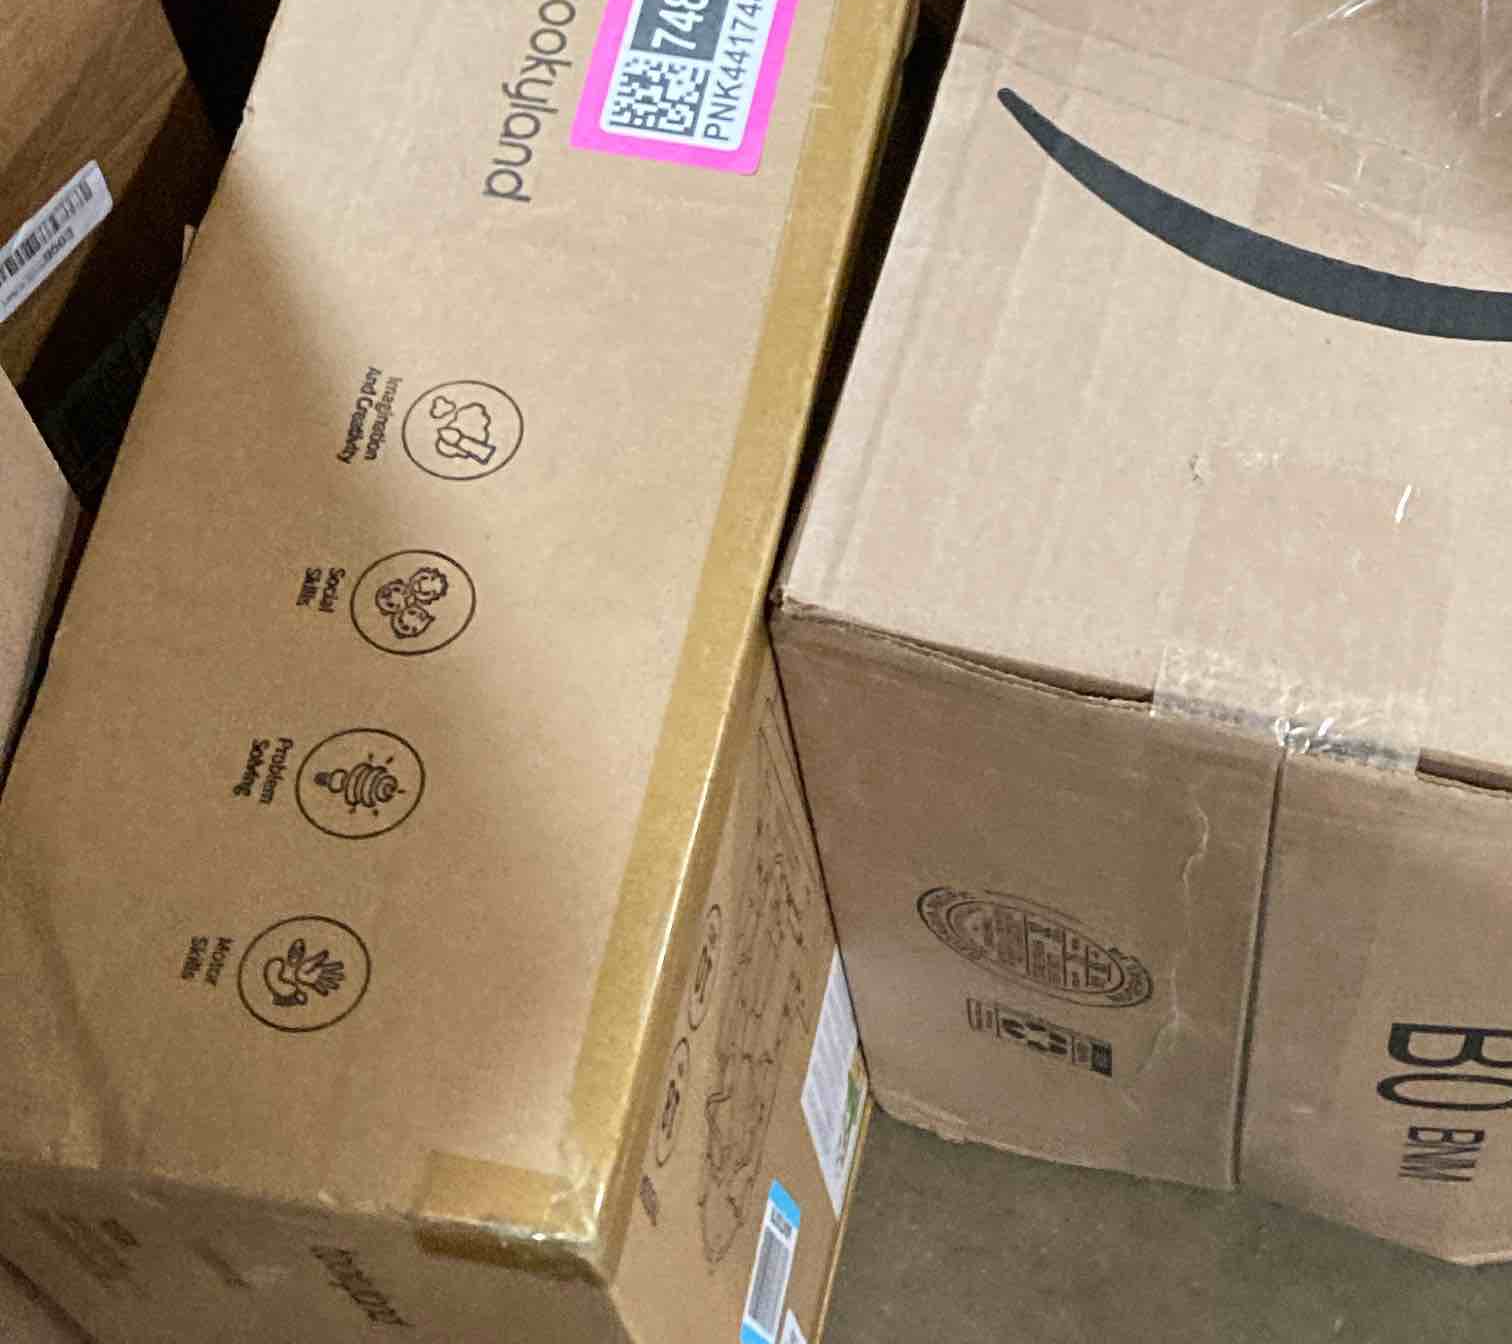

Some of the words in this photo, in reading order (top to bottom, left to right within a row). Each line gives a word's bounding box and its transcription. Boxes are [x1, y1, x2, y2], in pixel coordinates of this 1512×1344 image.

[363, 376, 404, 461] Imagination
[318, 567, 346, 614] Social
[259, 737, 294, 805] Problem
